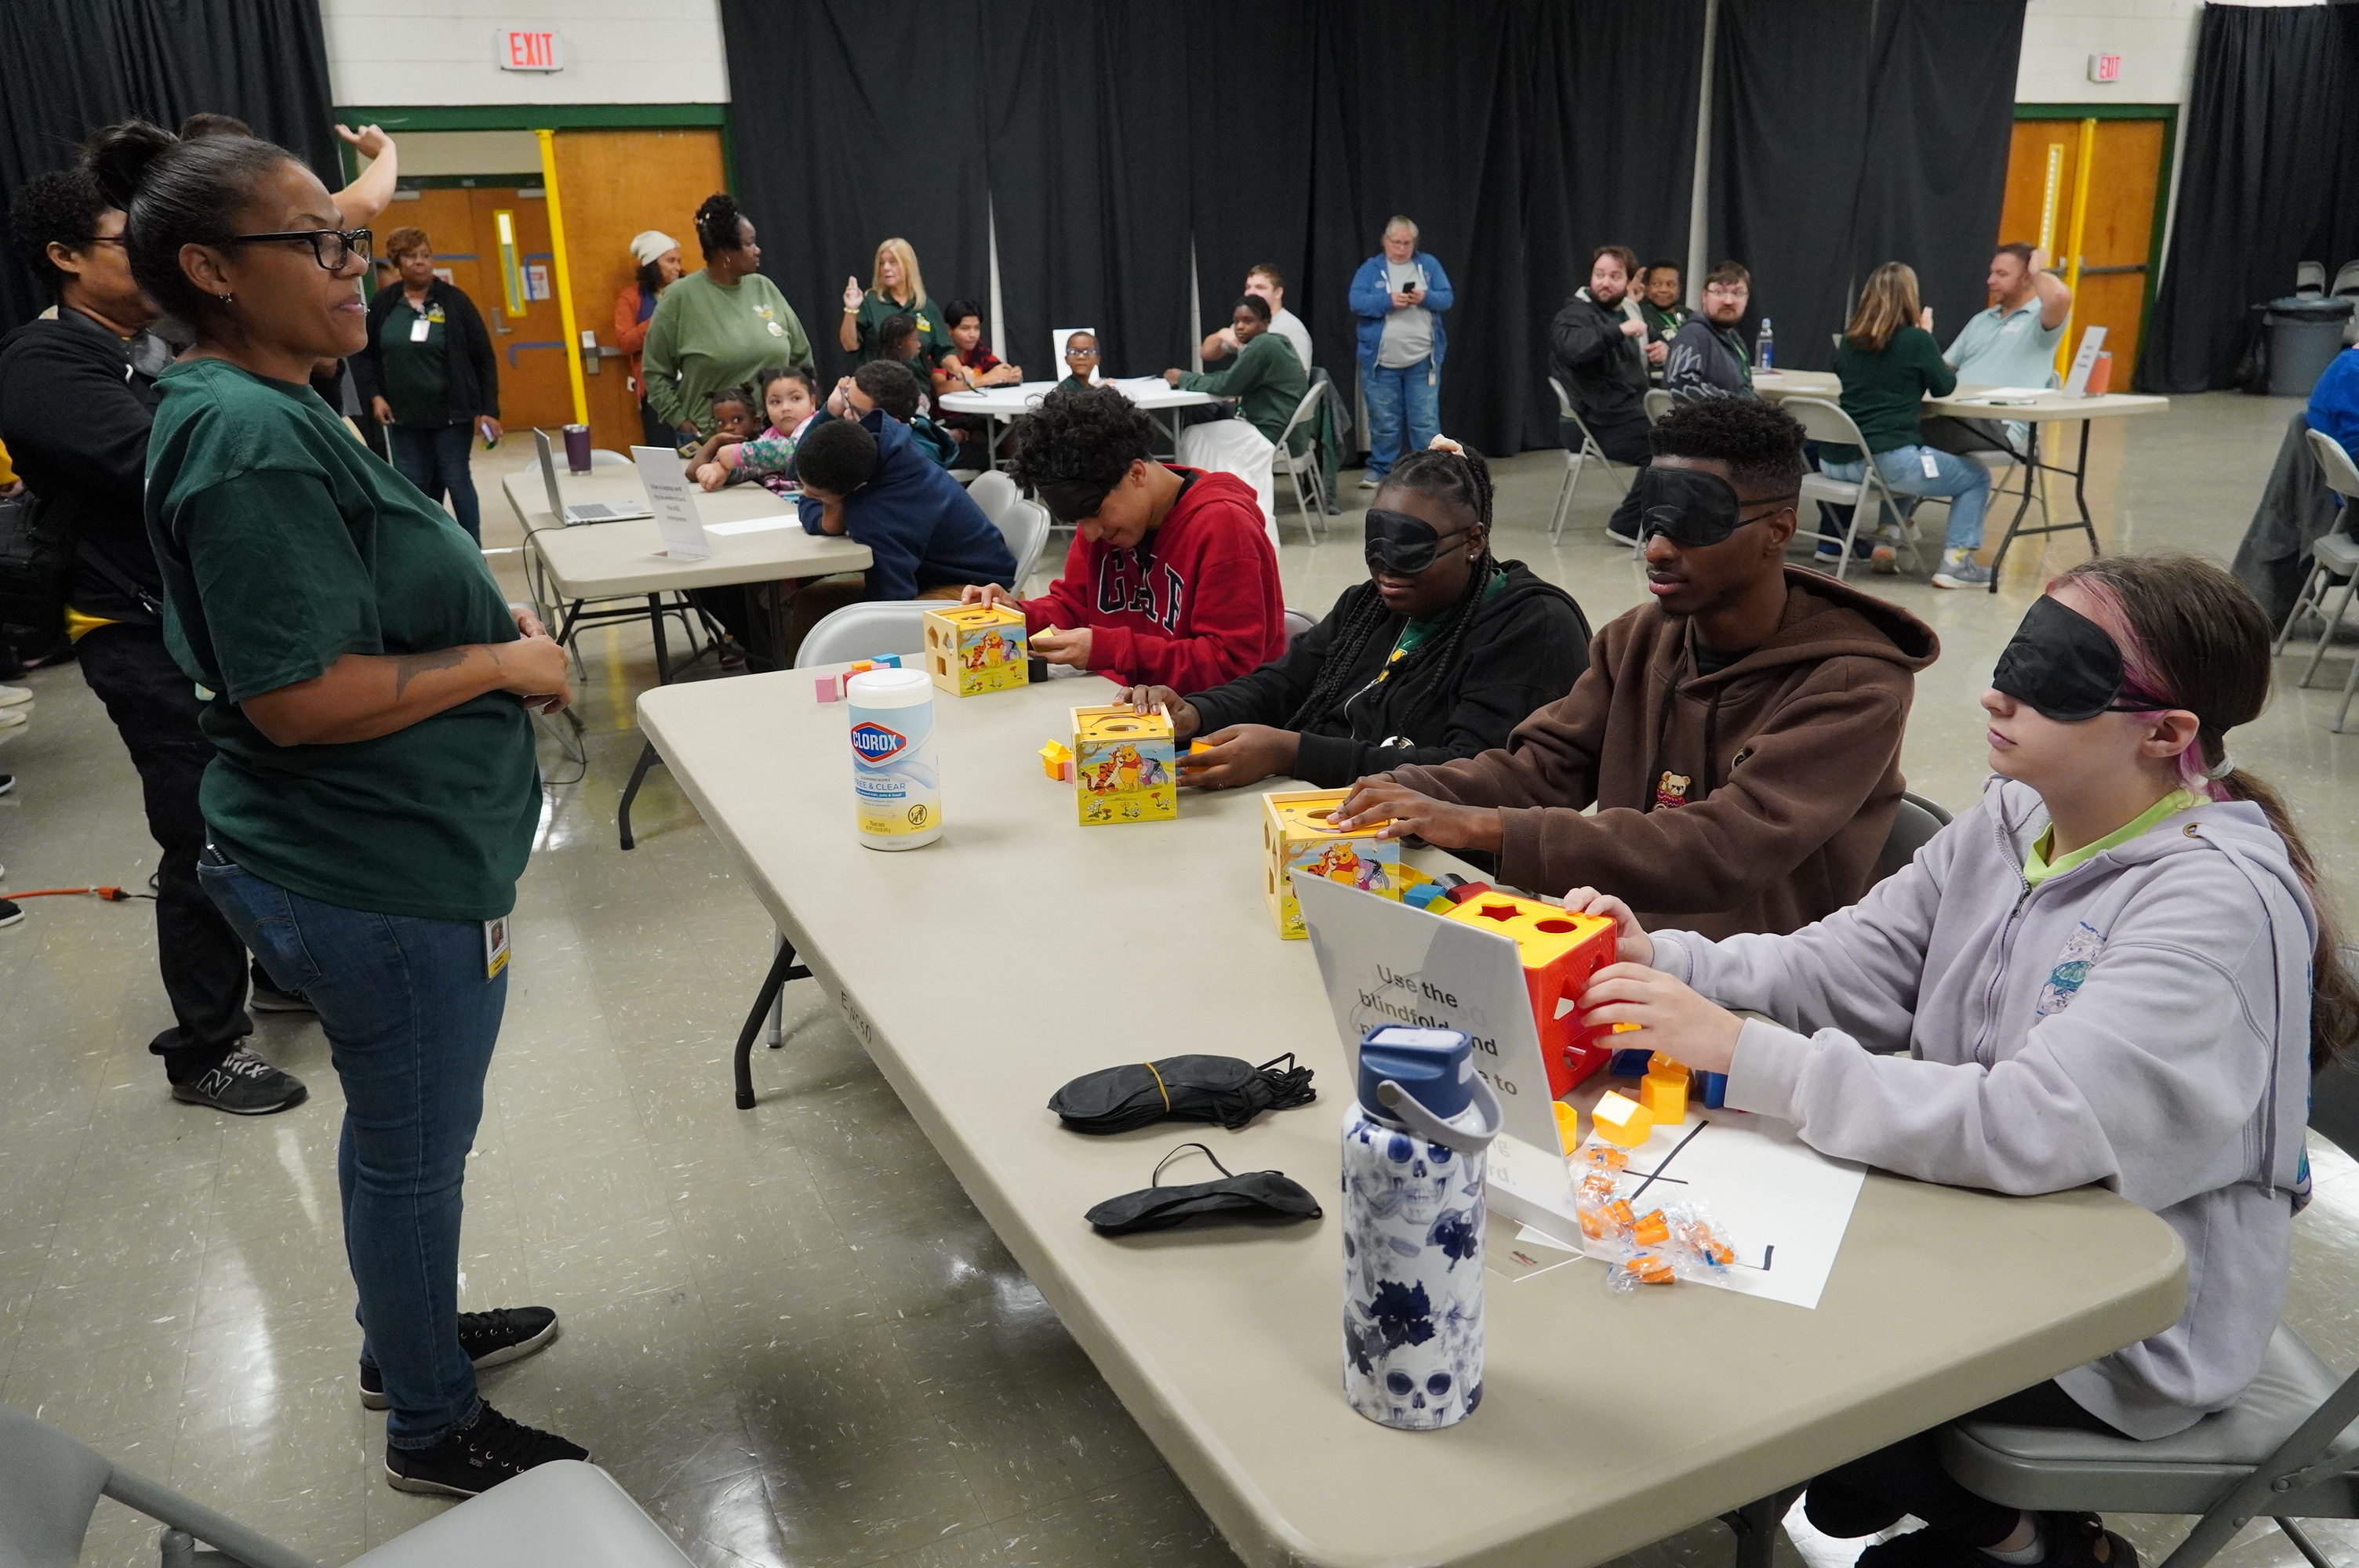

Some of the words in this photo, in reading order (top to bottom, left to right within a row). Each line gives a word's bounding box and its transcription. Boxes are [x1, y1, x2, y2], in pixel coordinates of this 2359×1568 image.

[509, 32, 553, 66] EXIT
[2099, 56, 2121, 78] EXIT
[1098, 548, 1184, 635] GAP
[852, 730, 899, 751] CLOROX
[876, 782, 906, 791] CLEAR
[1376, 964, 1418, 993] Use
[1421, 982, 1459, 1008] the
[1472, 1035, 1498, 1056] nd
[196, 1069, 233, 1099] N
[1493, 1073, 1518, 1095] to
